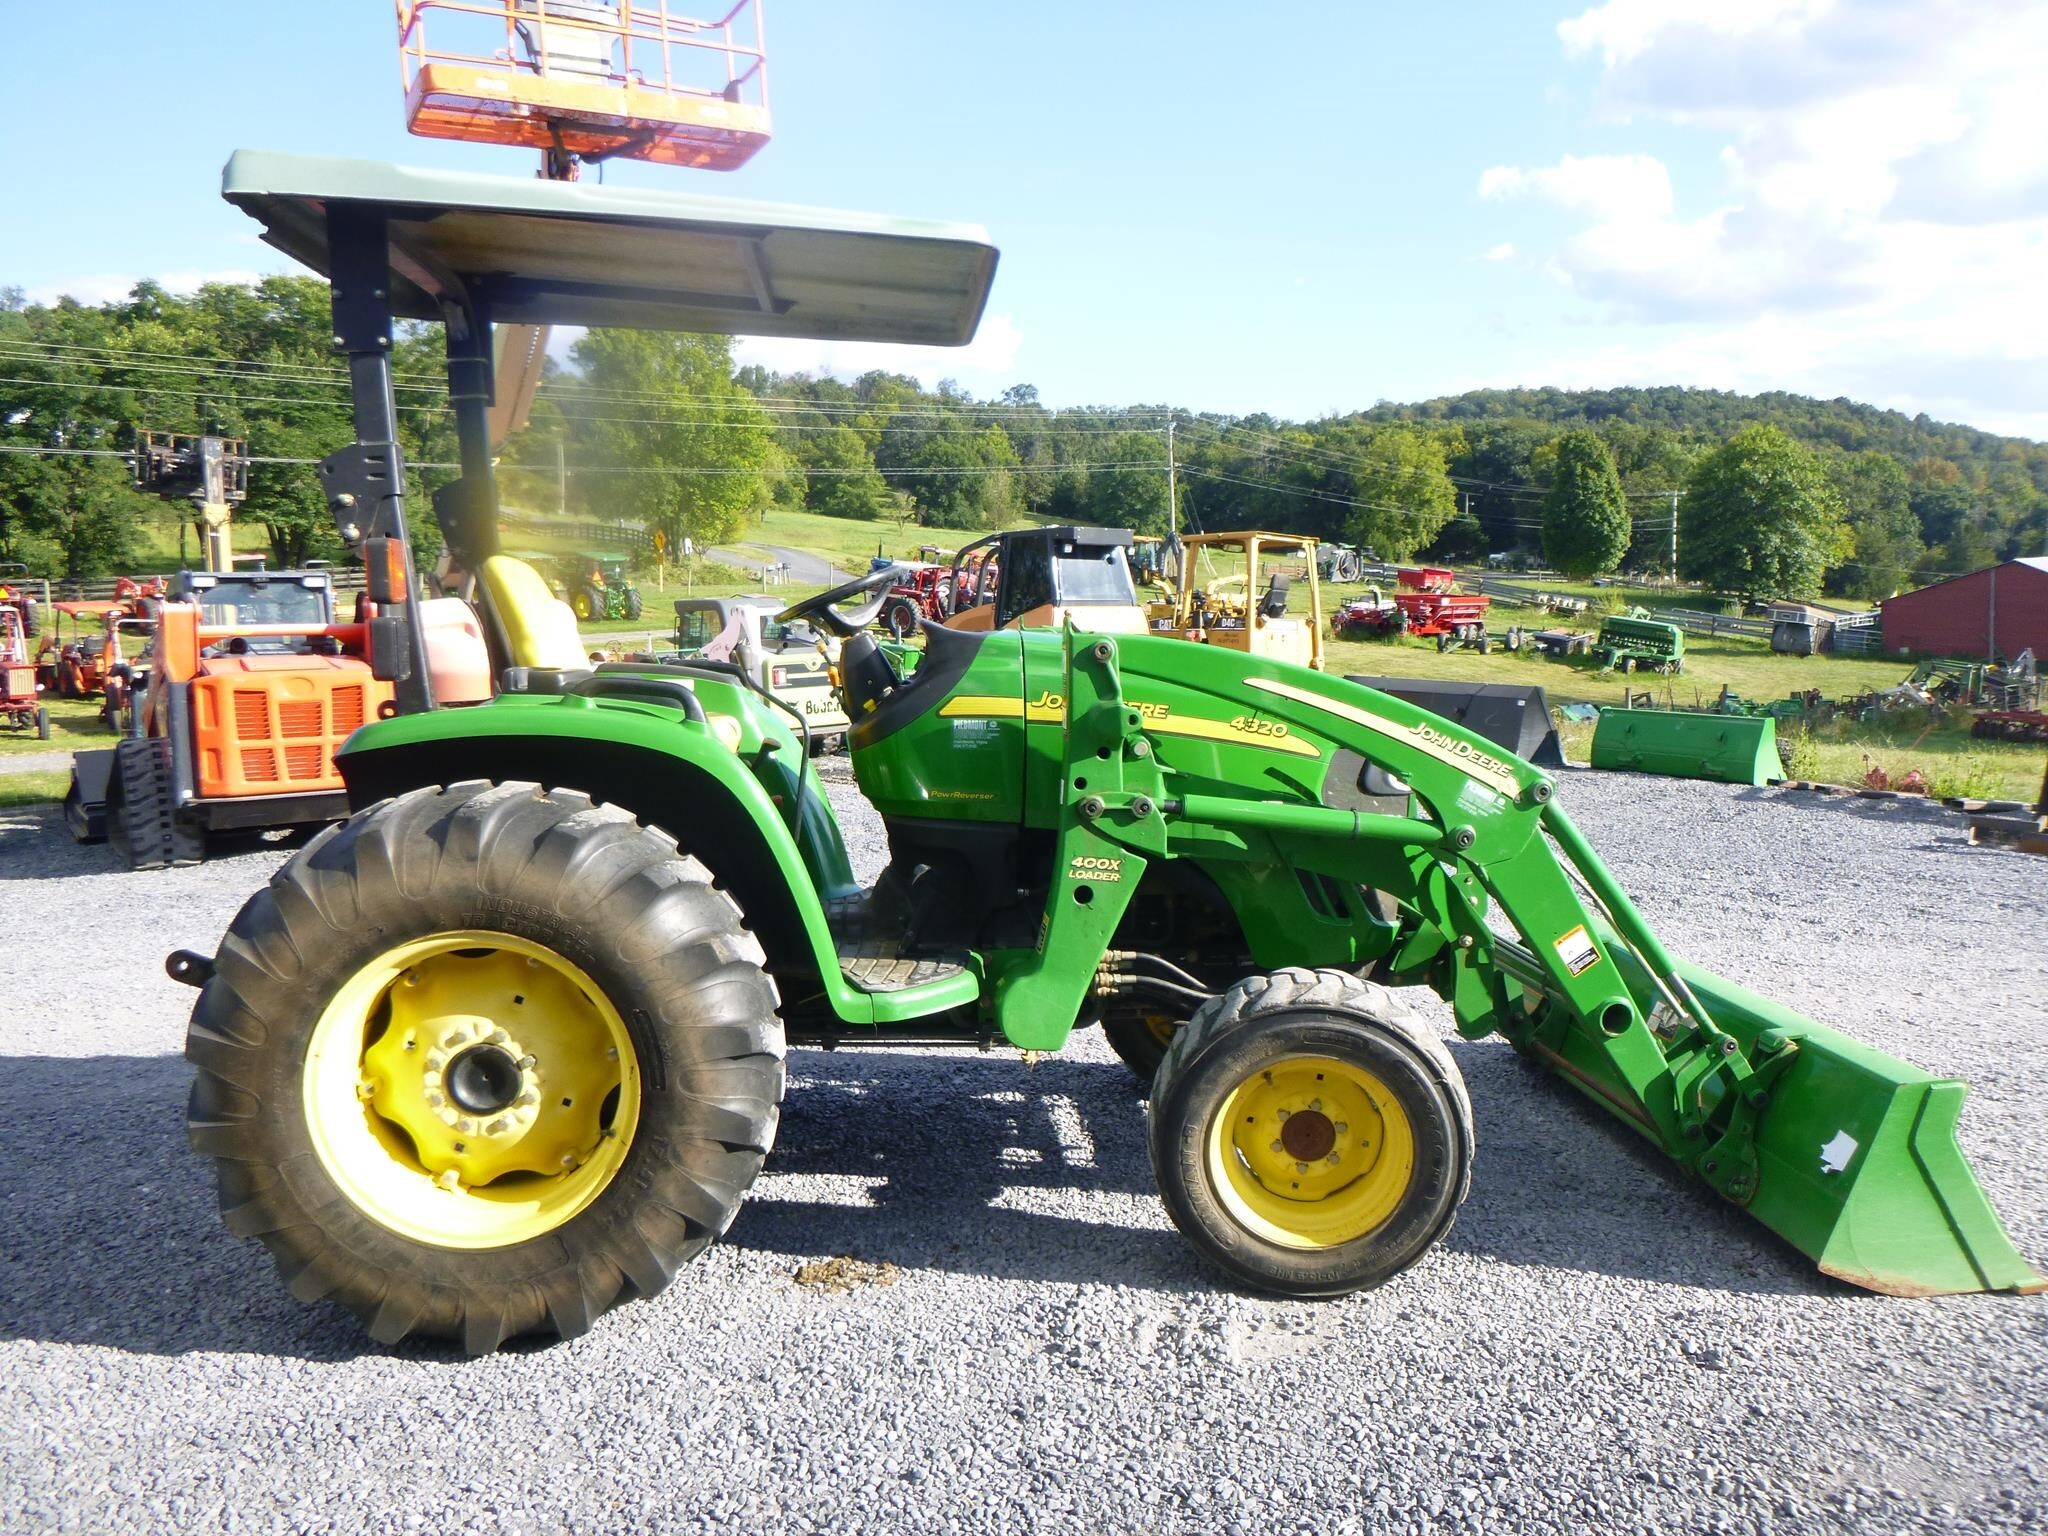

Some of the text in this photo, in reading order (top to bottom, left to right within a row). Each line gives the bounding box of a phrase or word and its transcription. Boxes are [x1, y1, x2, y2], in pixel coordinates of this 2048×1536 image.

[1159, 619, 1173, 630] CAT
[1221, 618, 1235, 628] D4C
[1230, 716, 1288, 738] 4320
[930, 790, 995, 800] PowrReverser
[1071, 856, 1121, 871] 400X
[1068, 869, 1121, 882] LOADER
